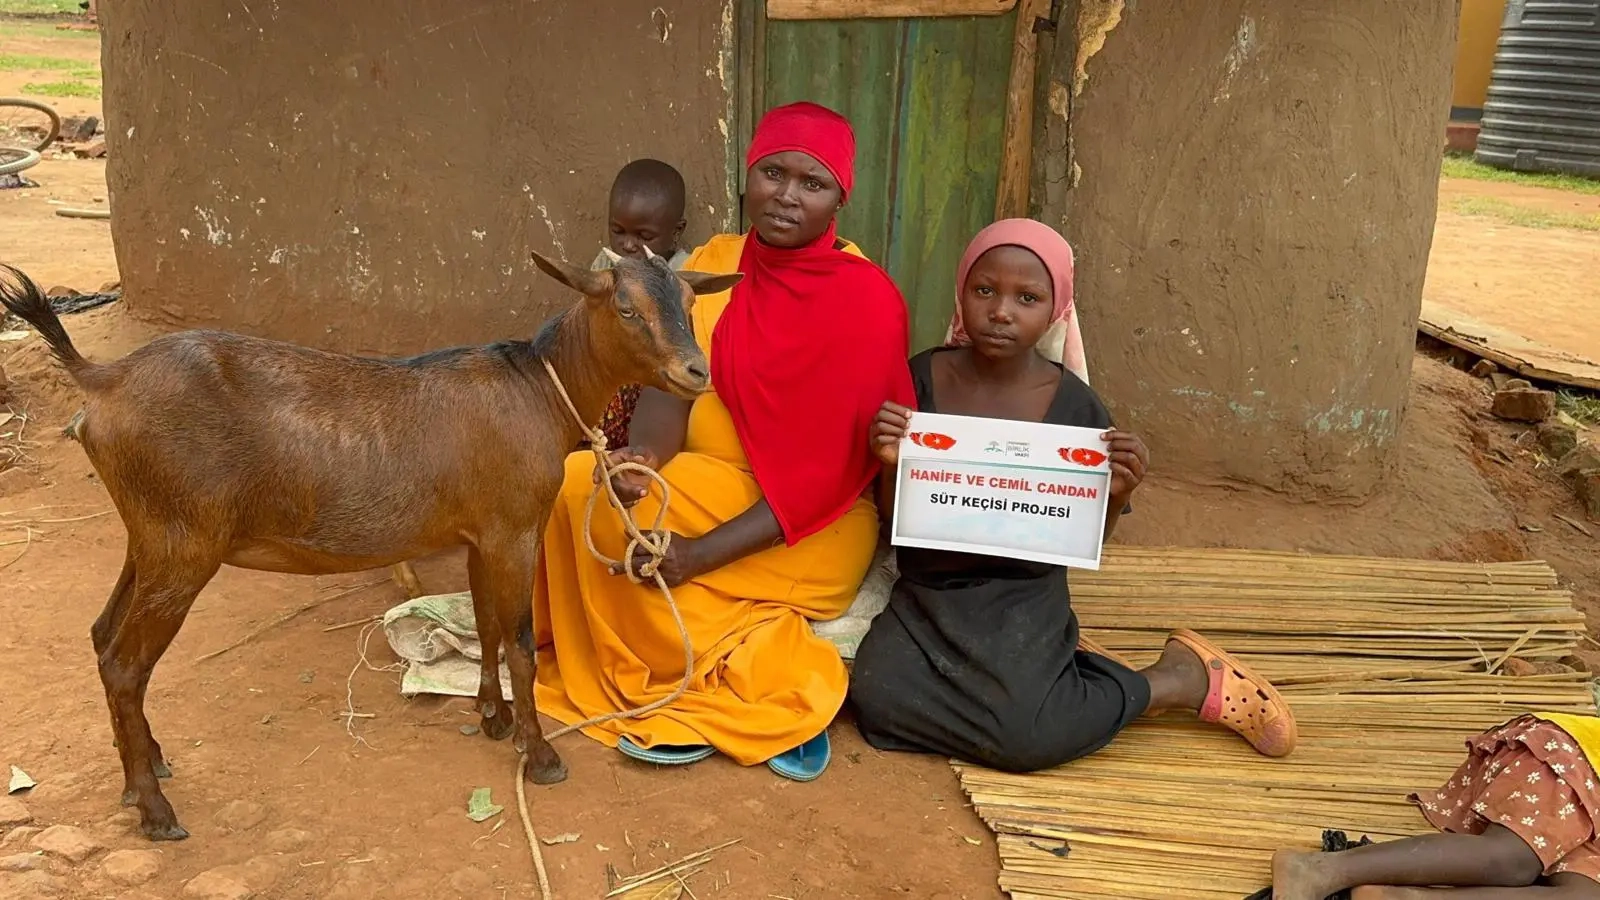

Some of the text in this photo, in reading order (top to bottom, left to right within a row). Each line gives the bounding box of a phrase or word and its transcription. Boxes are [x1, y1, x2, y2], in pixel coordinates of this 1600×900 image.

[910, 468, 1097, 499] HANİFE VE CEMİL CANDAN
[930, 492, 1071, 519] SÜT KEÇİSİ PROJESİ
